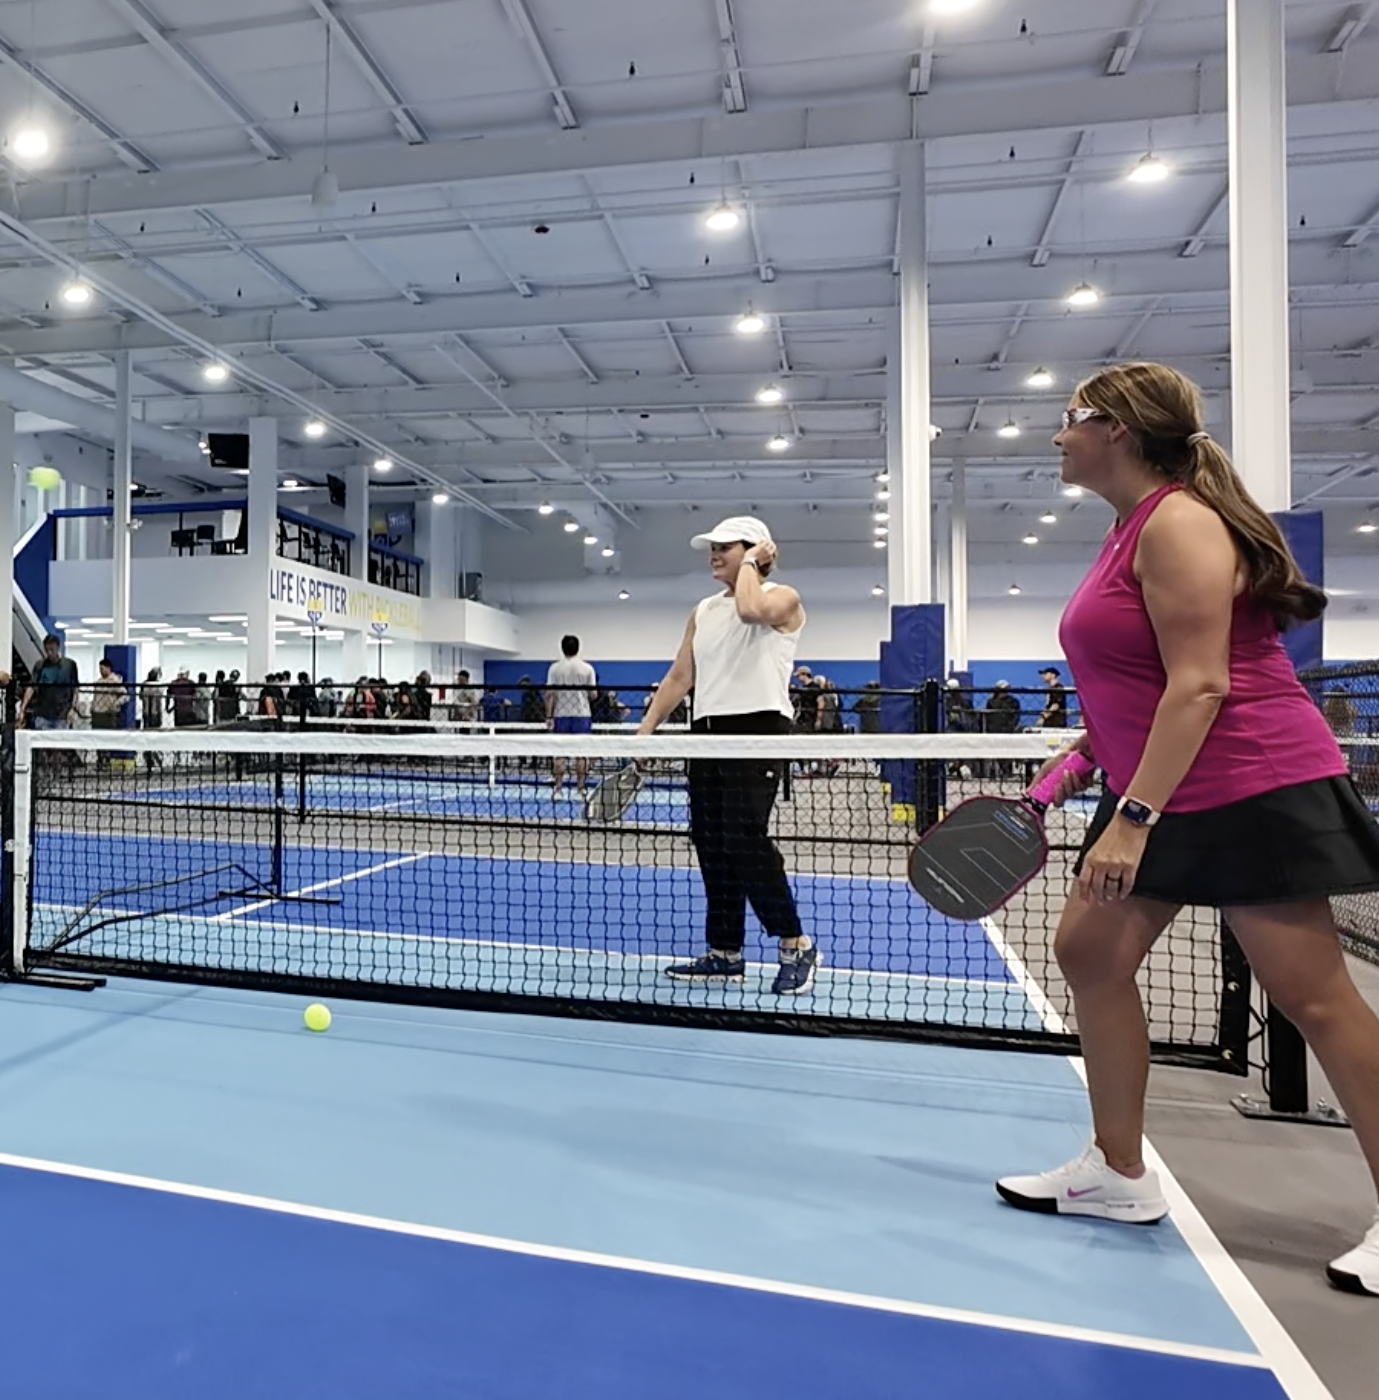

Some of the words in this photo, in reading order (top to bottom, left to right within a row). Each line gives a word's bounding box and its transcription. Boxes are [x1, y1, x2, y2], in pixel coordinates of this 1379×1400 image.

[270, 569, 293, 603] LIFE
[296, 575, 307, 606] IS
[309, 578, 347, 616] BETTER
[349, 588, 374, 620] WITH
